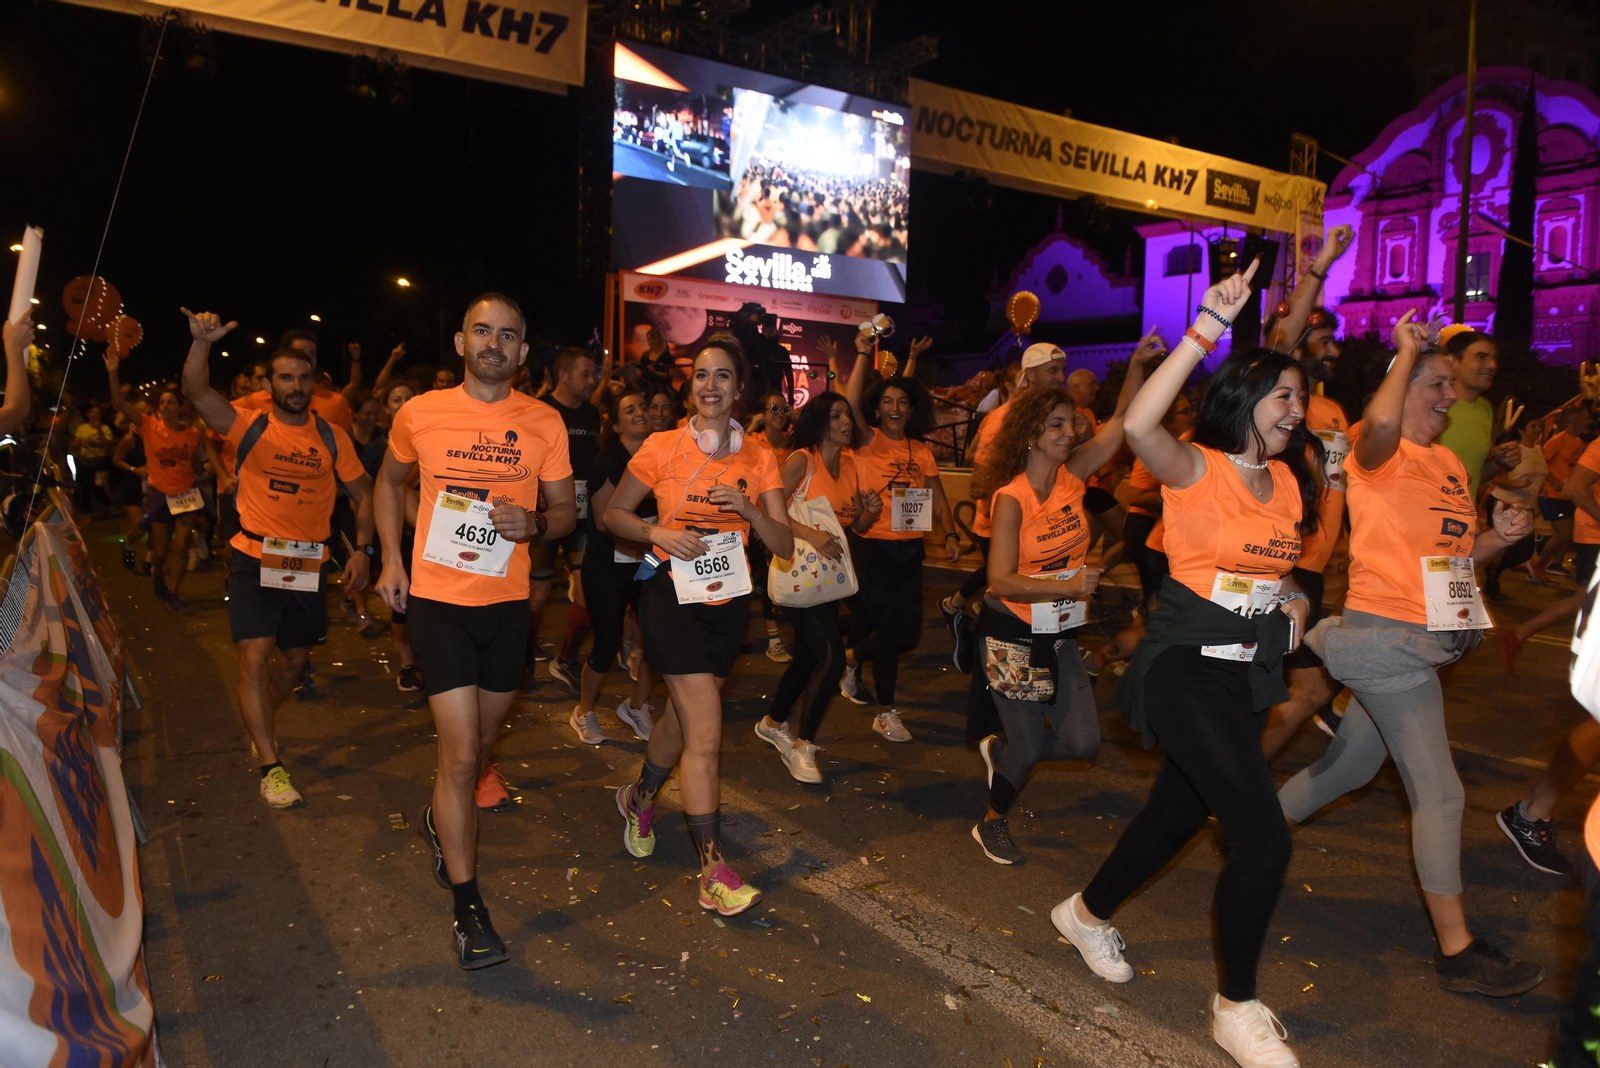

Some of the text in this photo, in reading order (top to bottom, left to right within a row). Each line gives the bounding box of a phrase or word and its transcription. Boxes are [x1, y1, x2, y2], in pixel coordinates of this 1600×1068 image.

[916, 106, 1052, 162] NOCTURNA
[1058, 140, 1146, 184] SEVILLA
[446, 449, 493, 463] SEVILLA
[471, 444, 521, 457] NOCTURNA
[274, 453, 304, 466] SEVILLA
[901, 502, 924, 514] 10207
[1048, 513, 1079, 531] NOCTURNA
[455, 523, 498, 547] 4630
[1036, 527, 1067, 543] SEVILLA
[1242, 543, 1287, 561] SEVILLA
[282, 557, 303, 571] 803
[694, 555, 730, 576] 6568
[1448, 581, 1473, 599] 8892
